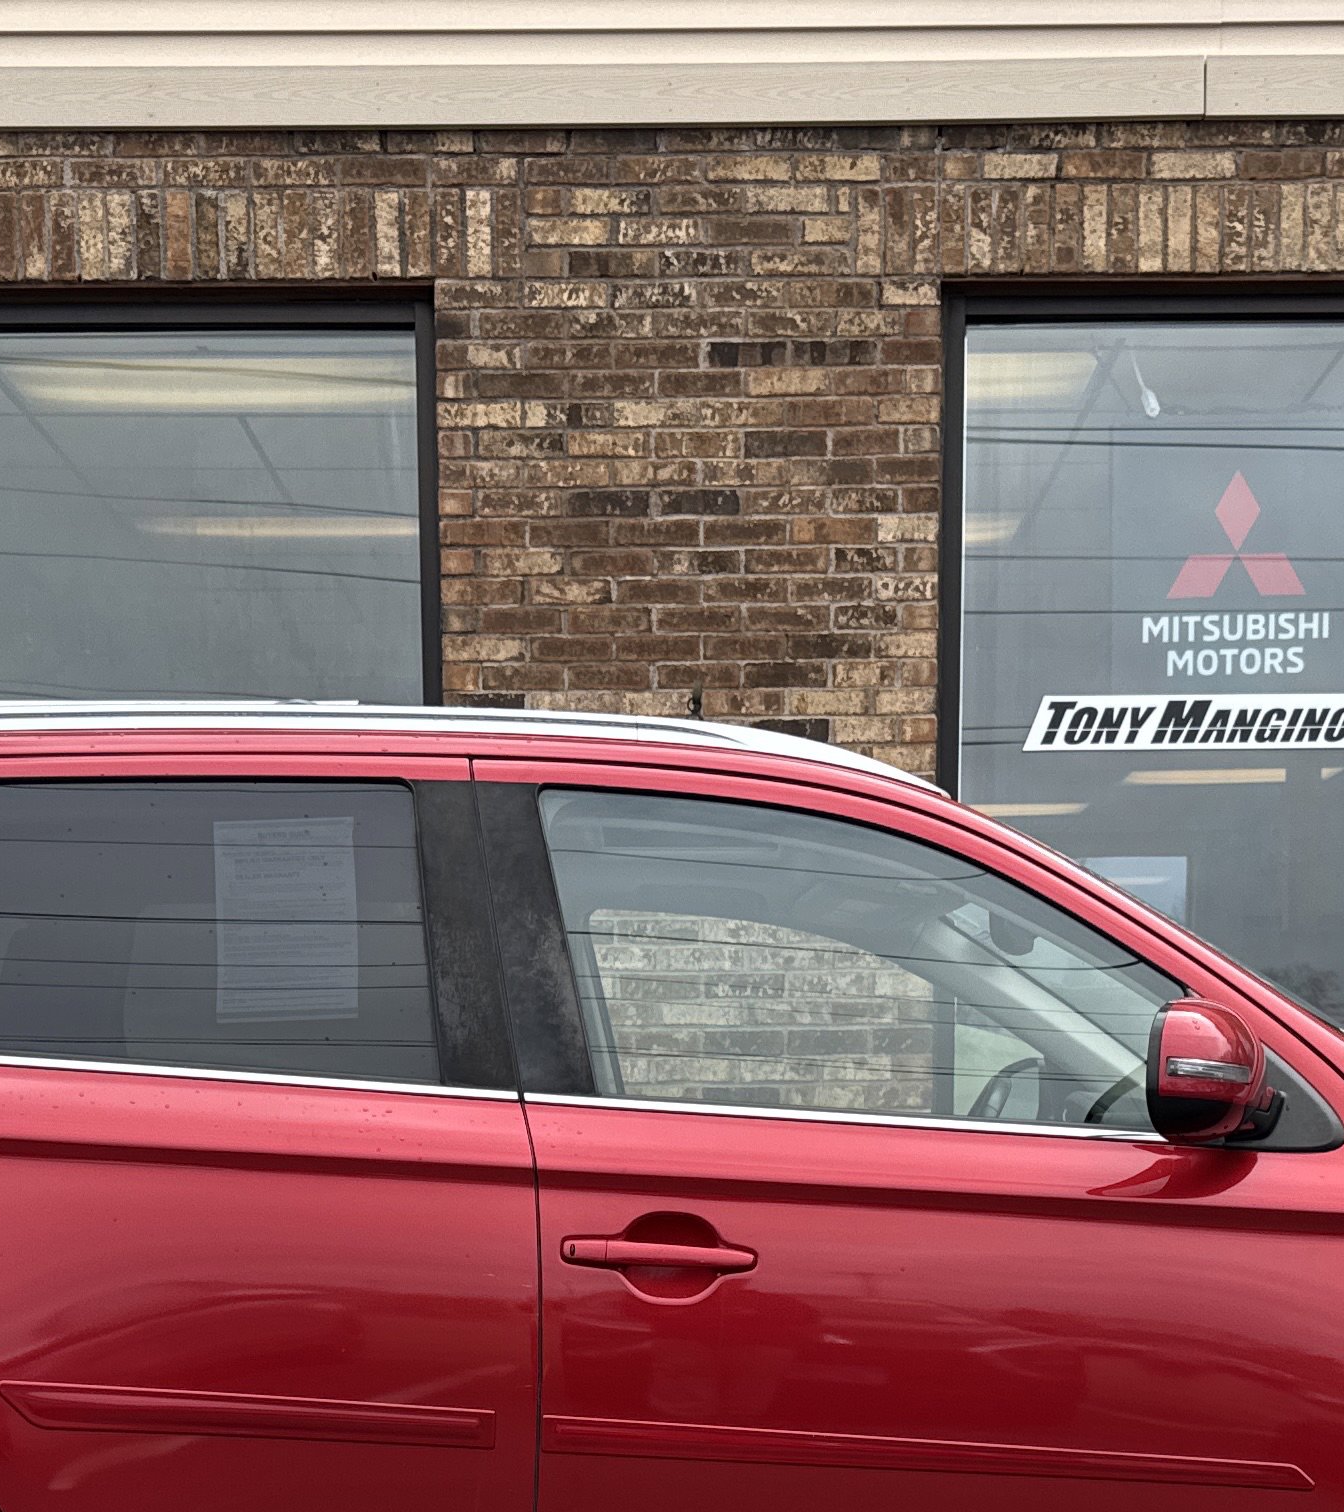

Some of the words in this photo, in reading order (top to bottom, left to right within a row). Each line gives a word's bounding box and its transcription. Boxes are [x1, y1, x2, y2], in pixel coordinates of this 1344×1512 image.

[1141, 612, 1330, 644] MITSUBISHI
[1166, 646, 1305, 677] MOTORS
[1040, 701, 1156, 745] TONY
